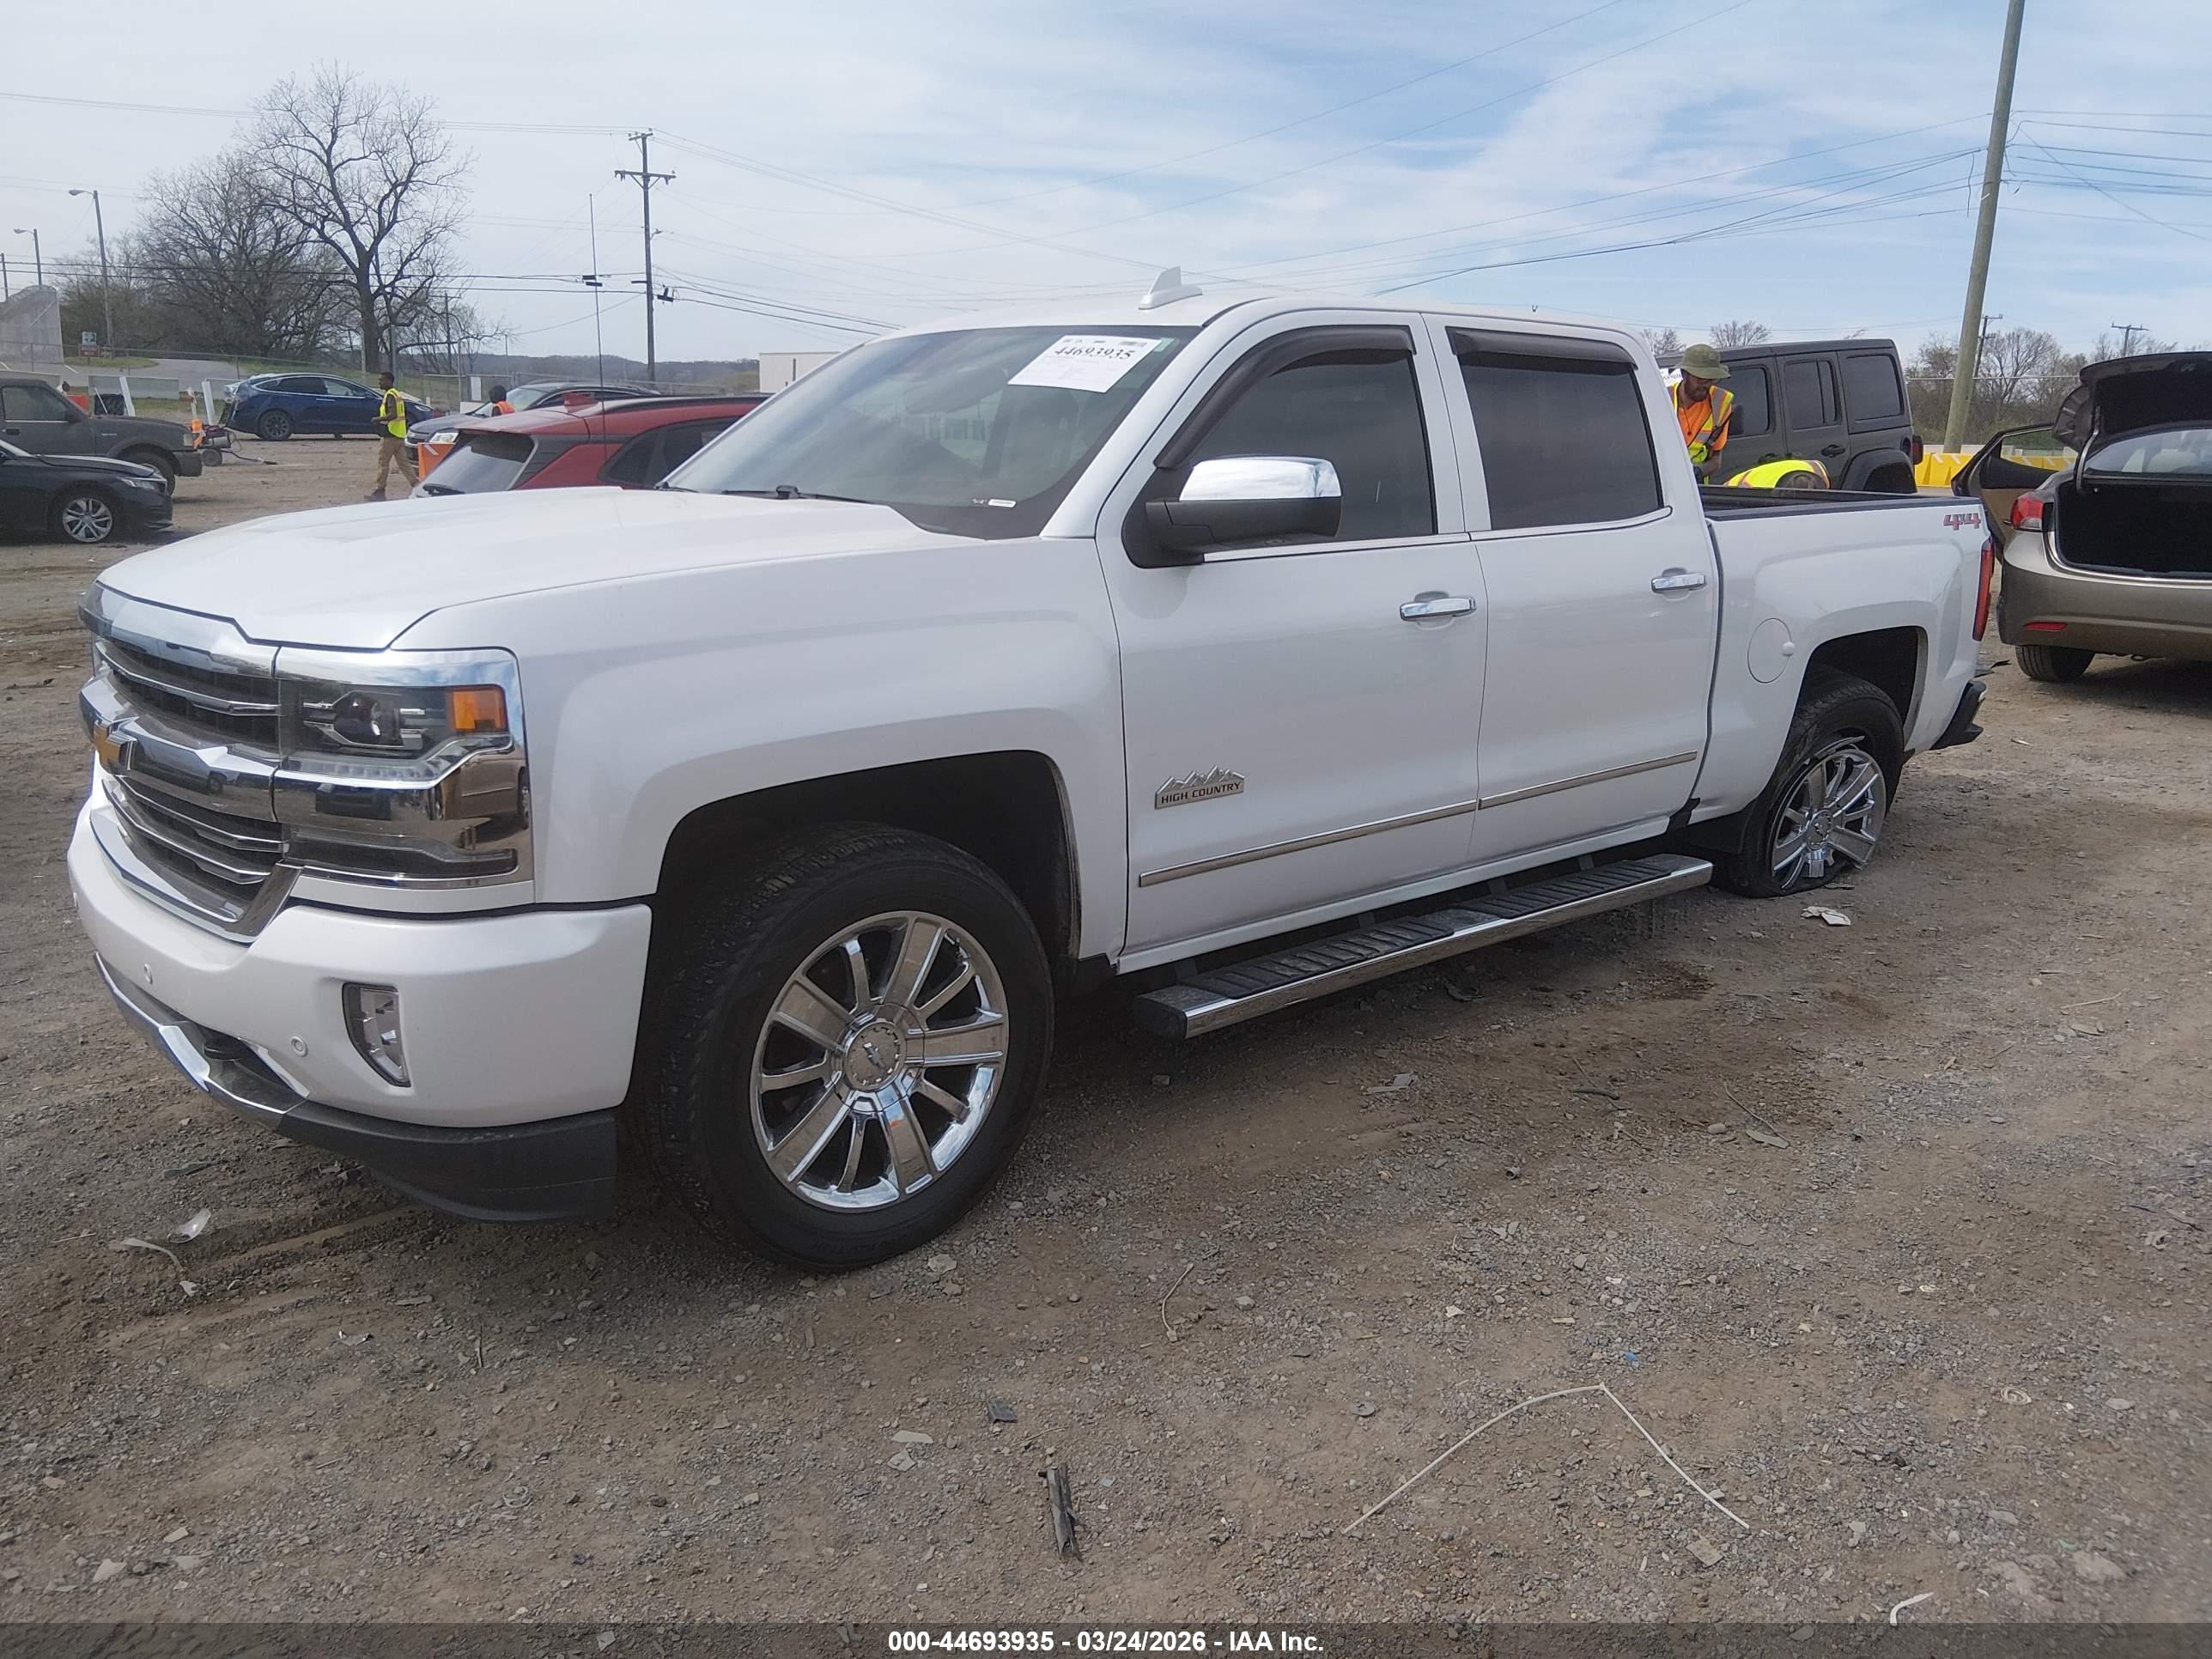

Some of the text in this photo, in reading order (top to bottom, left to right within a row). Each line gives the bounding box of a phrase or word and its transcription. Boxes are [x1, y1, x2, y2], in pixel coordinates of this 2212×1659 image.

[1054, 345, 1136, 360] 44693935
[1161, 782, 1242, 804] HIGH COUNTRY
